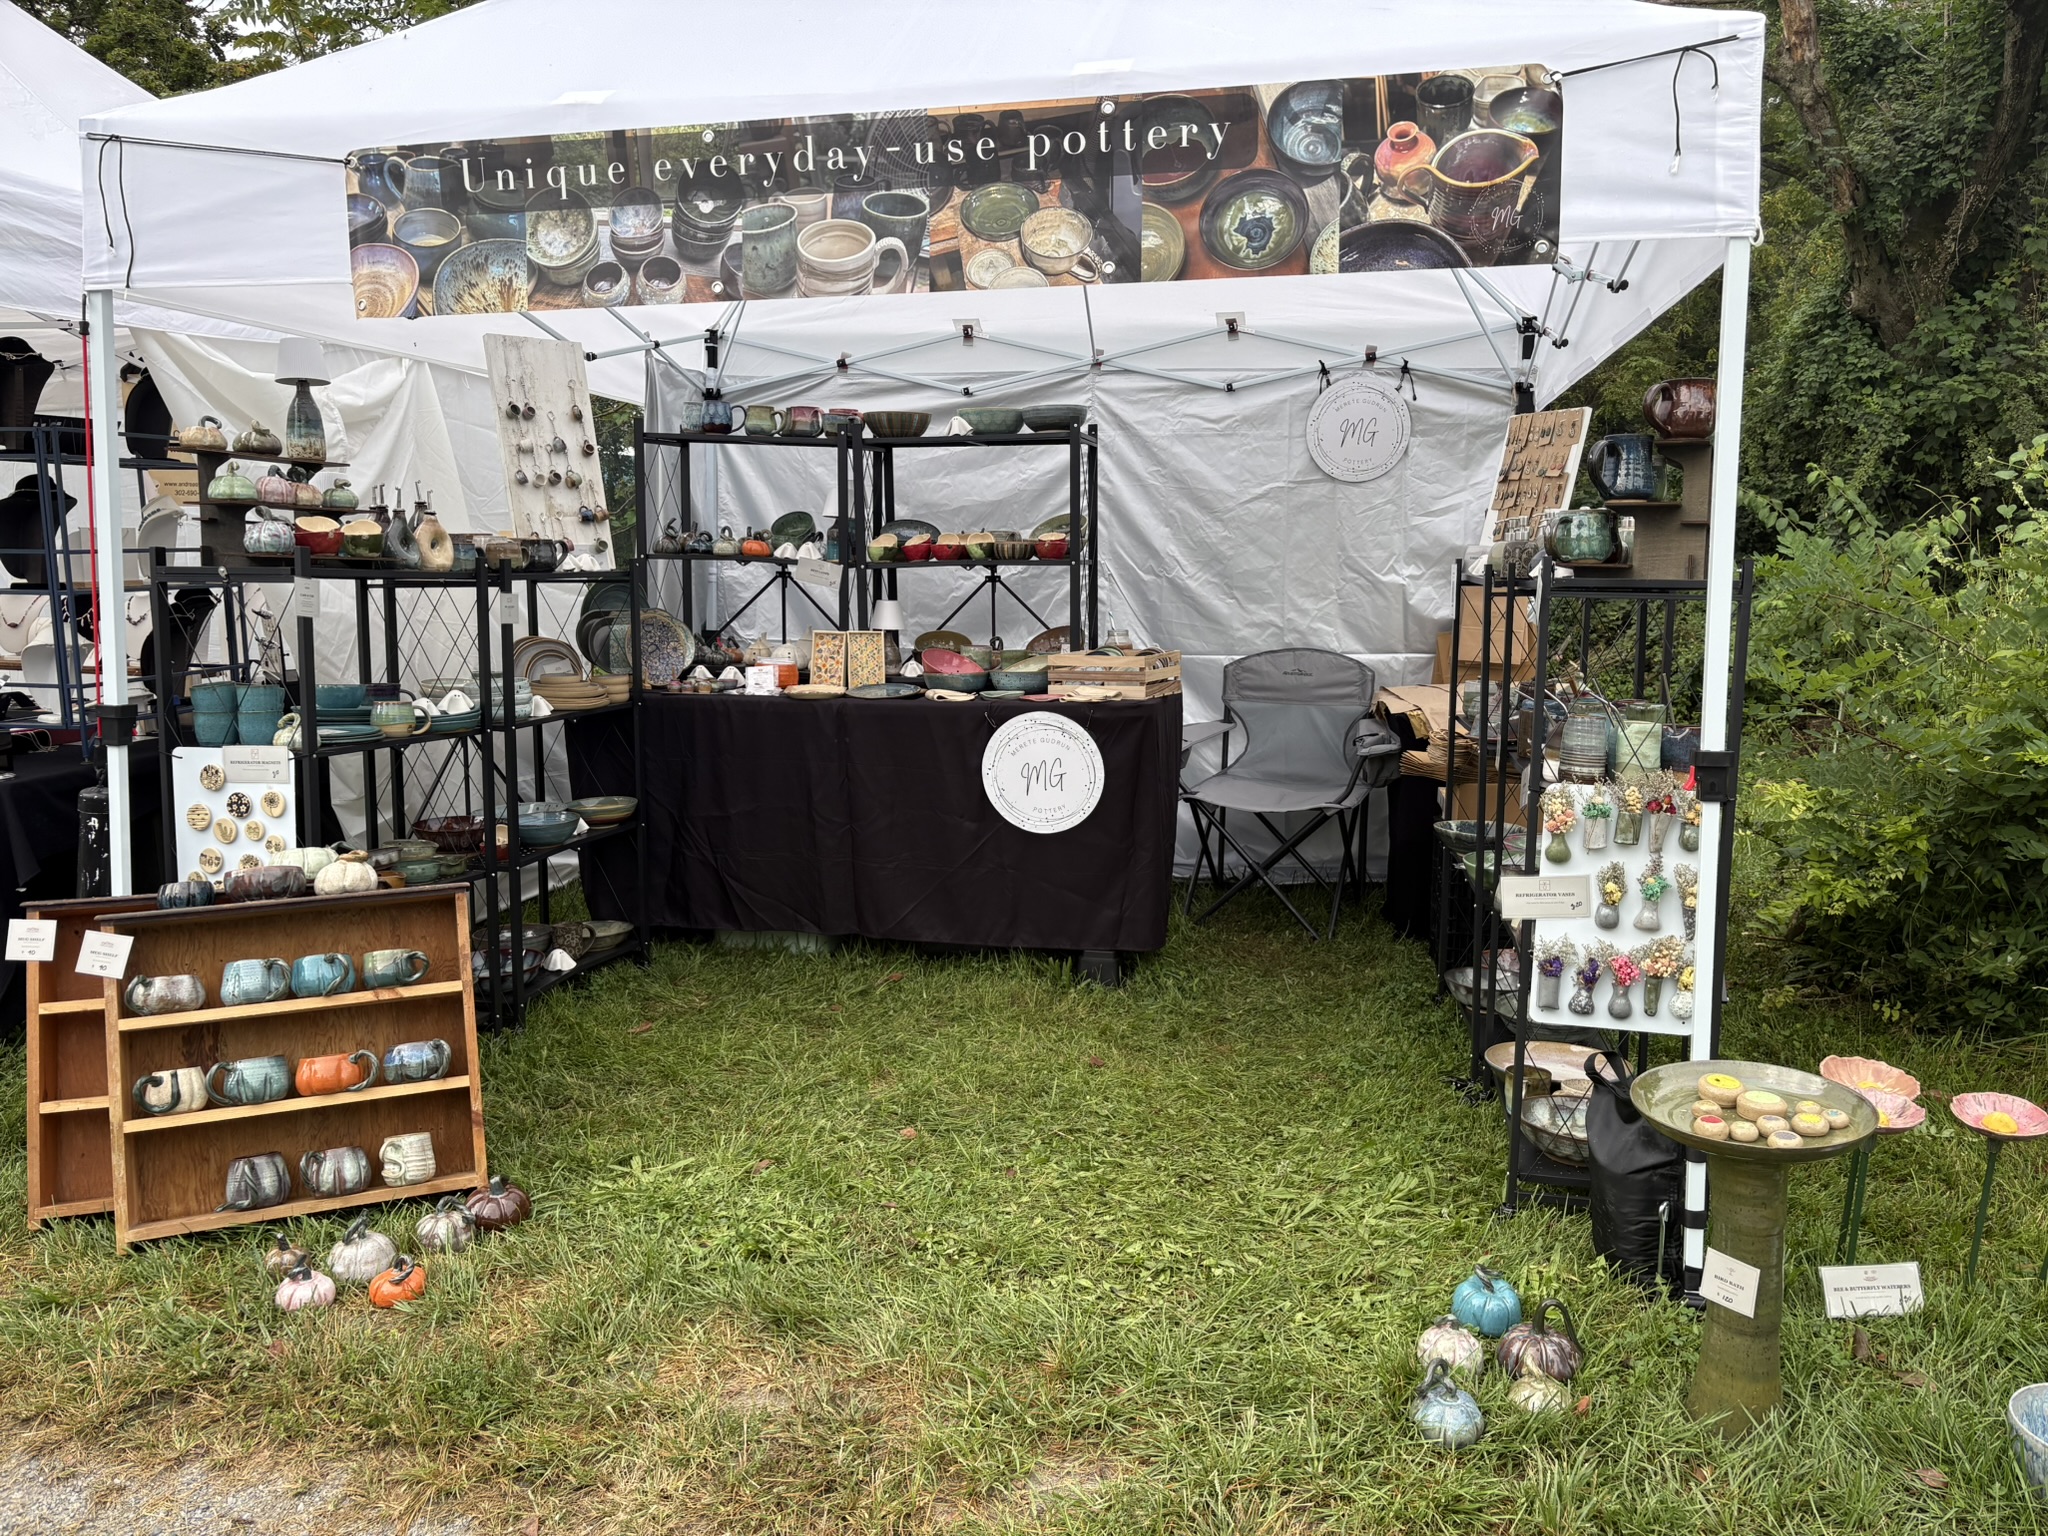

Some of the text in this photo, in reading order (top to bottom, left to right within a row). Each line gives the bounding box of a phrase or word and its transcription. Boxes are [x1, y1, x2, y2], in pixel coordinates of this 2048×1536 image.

[459, 118, 1232, 200] Unique everyday-use pottery
[1339, 417, 1380, 448] MG
[1010, 737, 1071, 757] MERETE GUDRUN
[1020, 757, 1067, 796] MG
[1033, 804, 1066, 814] POTTERY
